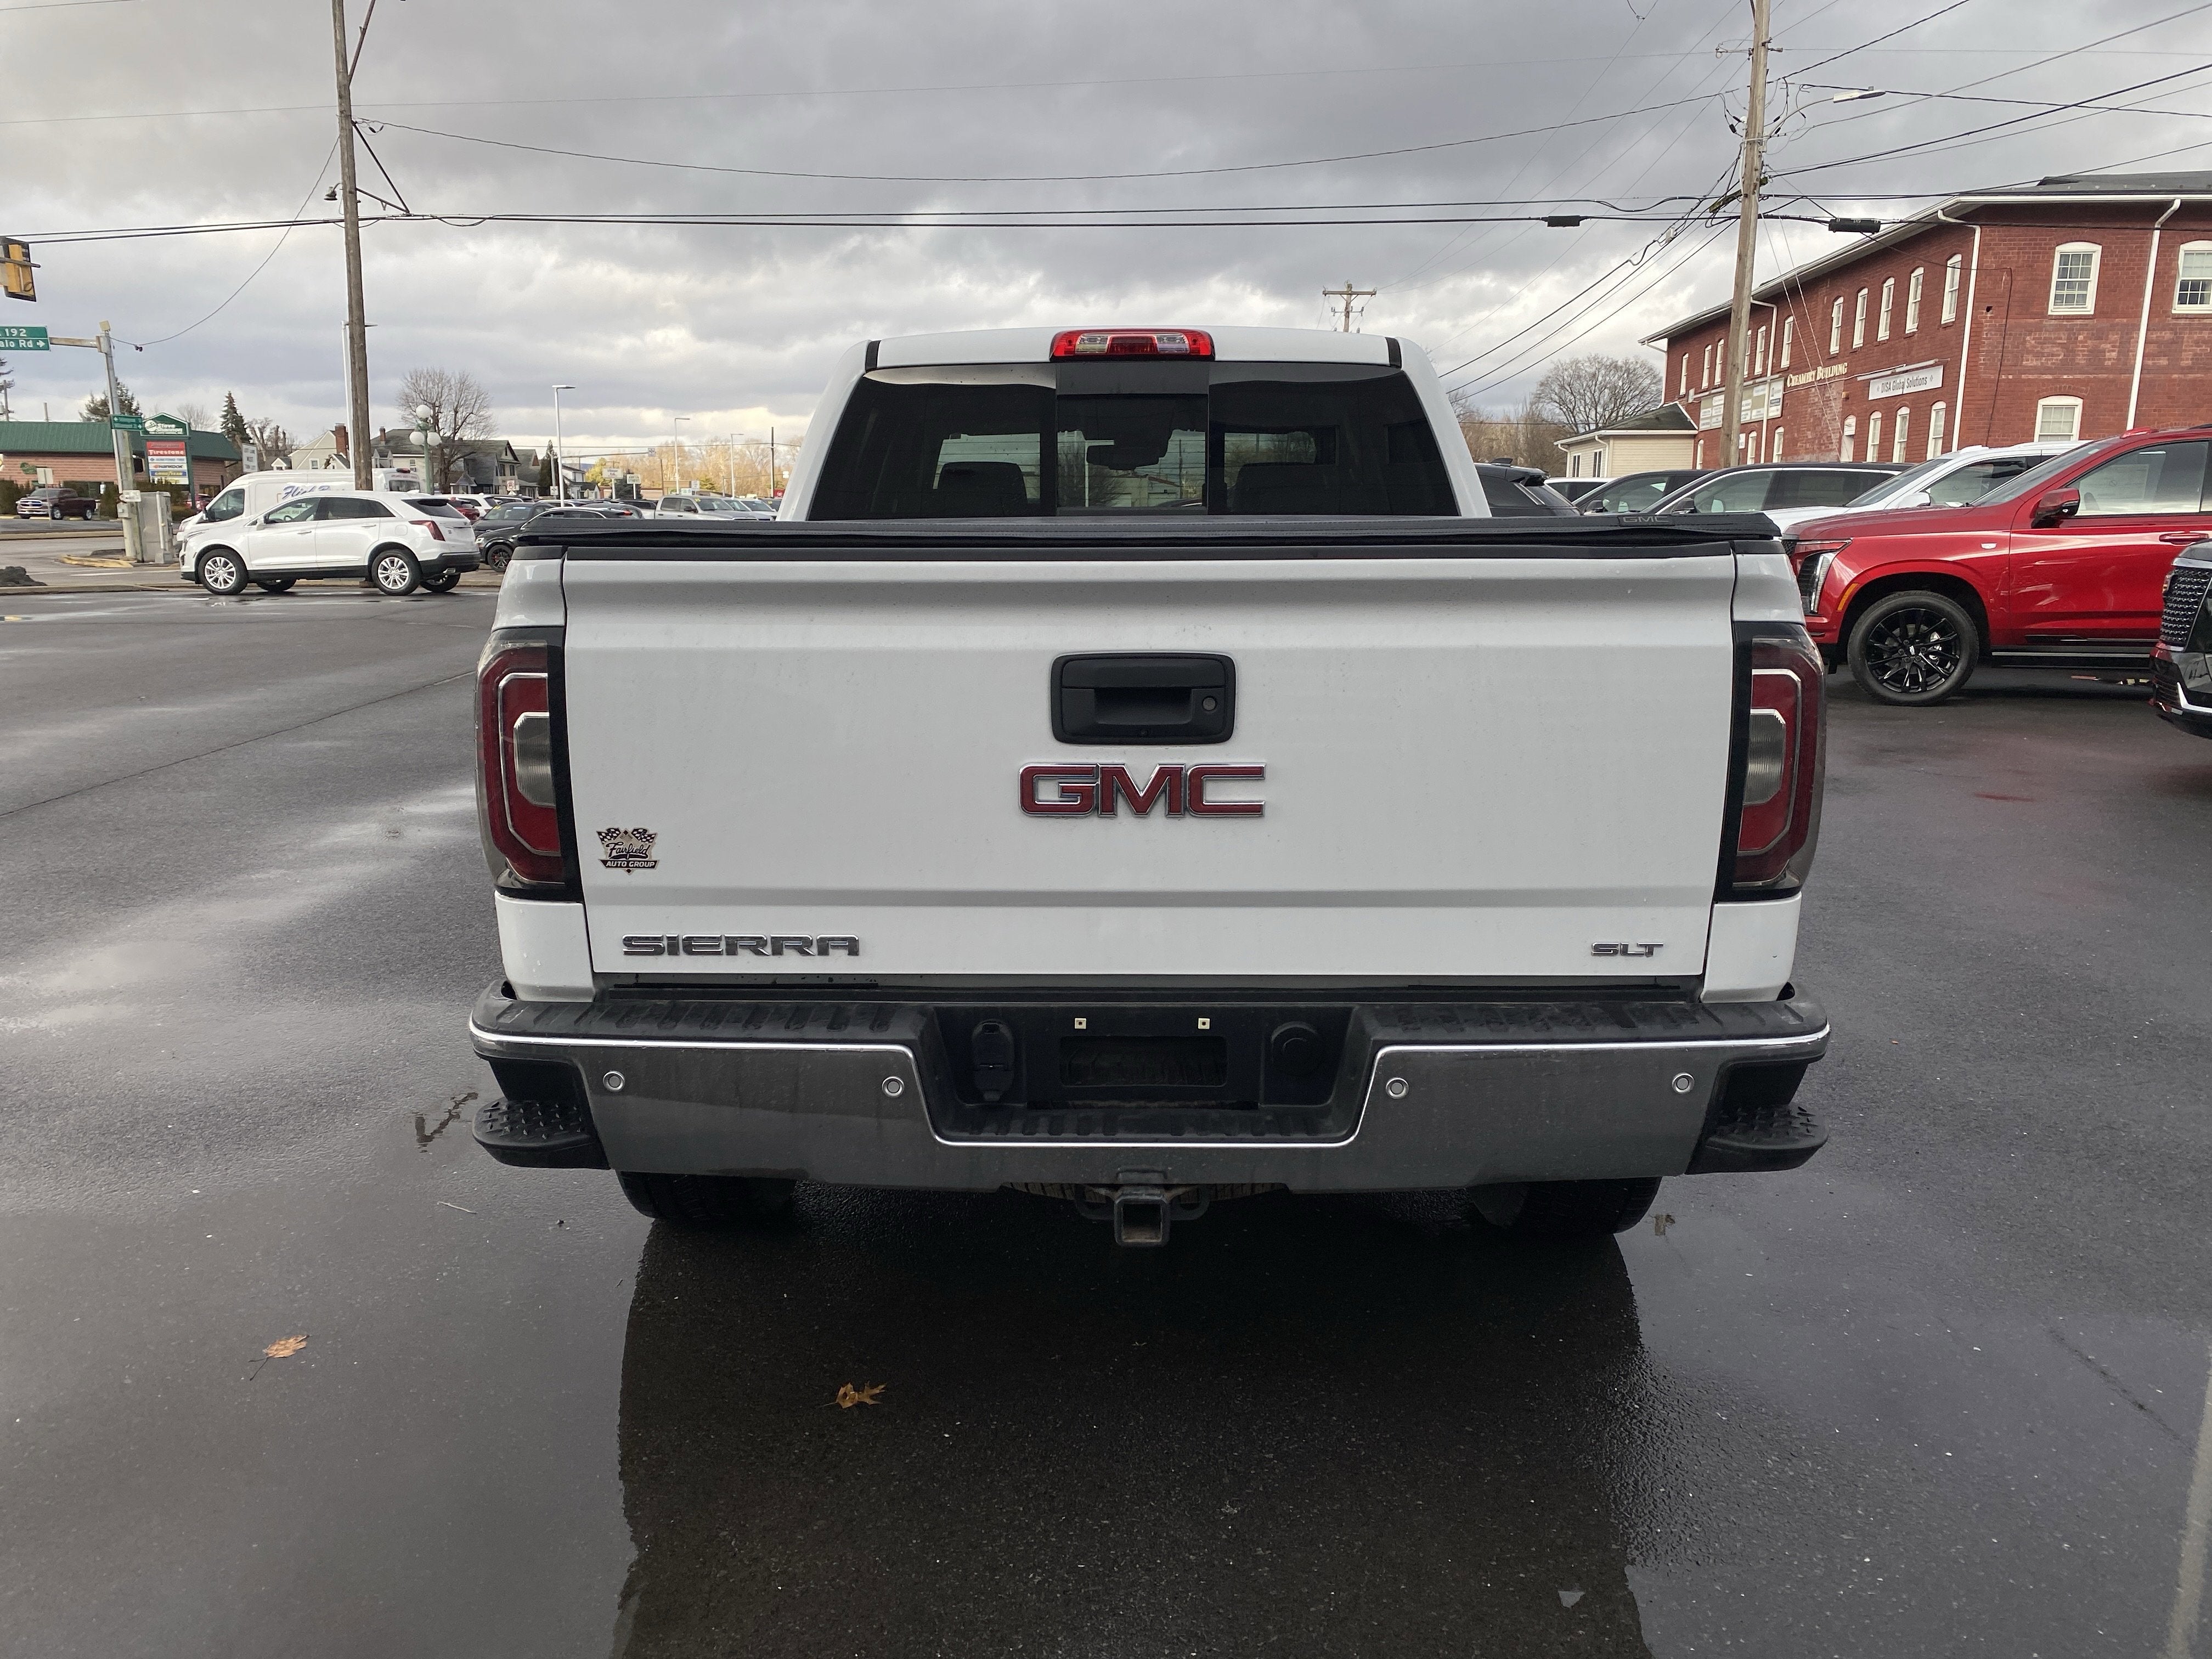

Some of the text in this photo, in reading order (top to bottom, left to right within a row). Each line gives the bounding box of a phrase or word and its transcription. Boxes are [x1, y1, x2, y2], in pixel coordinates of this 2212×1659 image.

[1816, 362, 1848, 381] BUILDING
[1881, 376, 1927, 393] DISA Global Solutions
[1019, 763, 1266, 817] GMC
[606, 842, 651, 860] Fairfield
[623, 934, 860, 956] SIERRA
[1592, 942, 1664, 957] SLT
